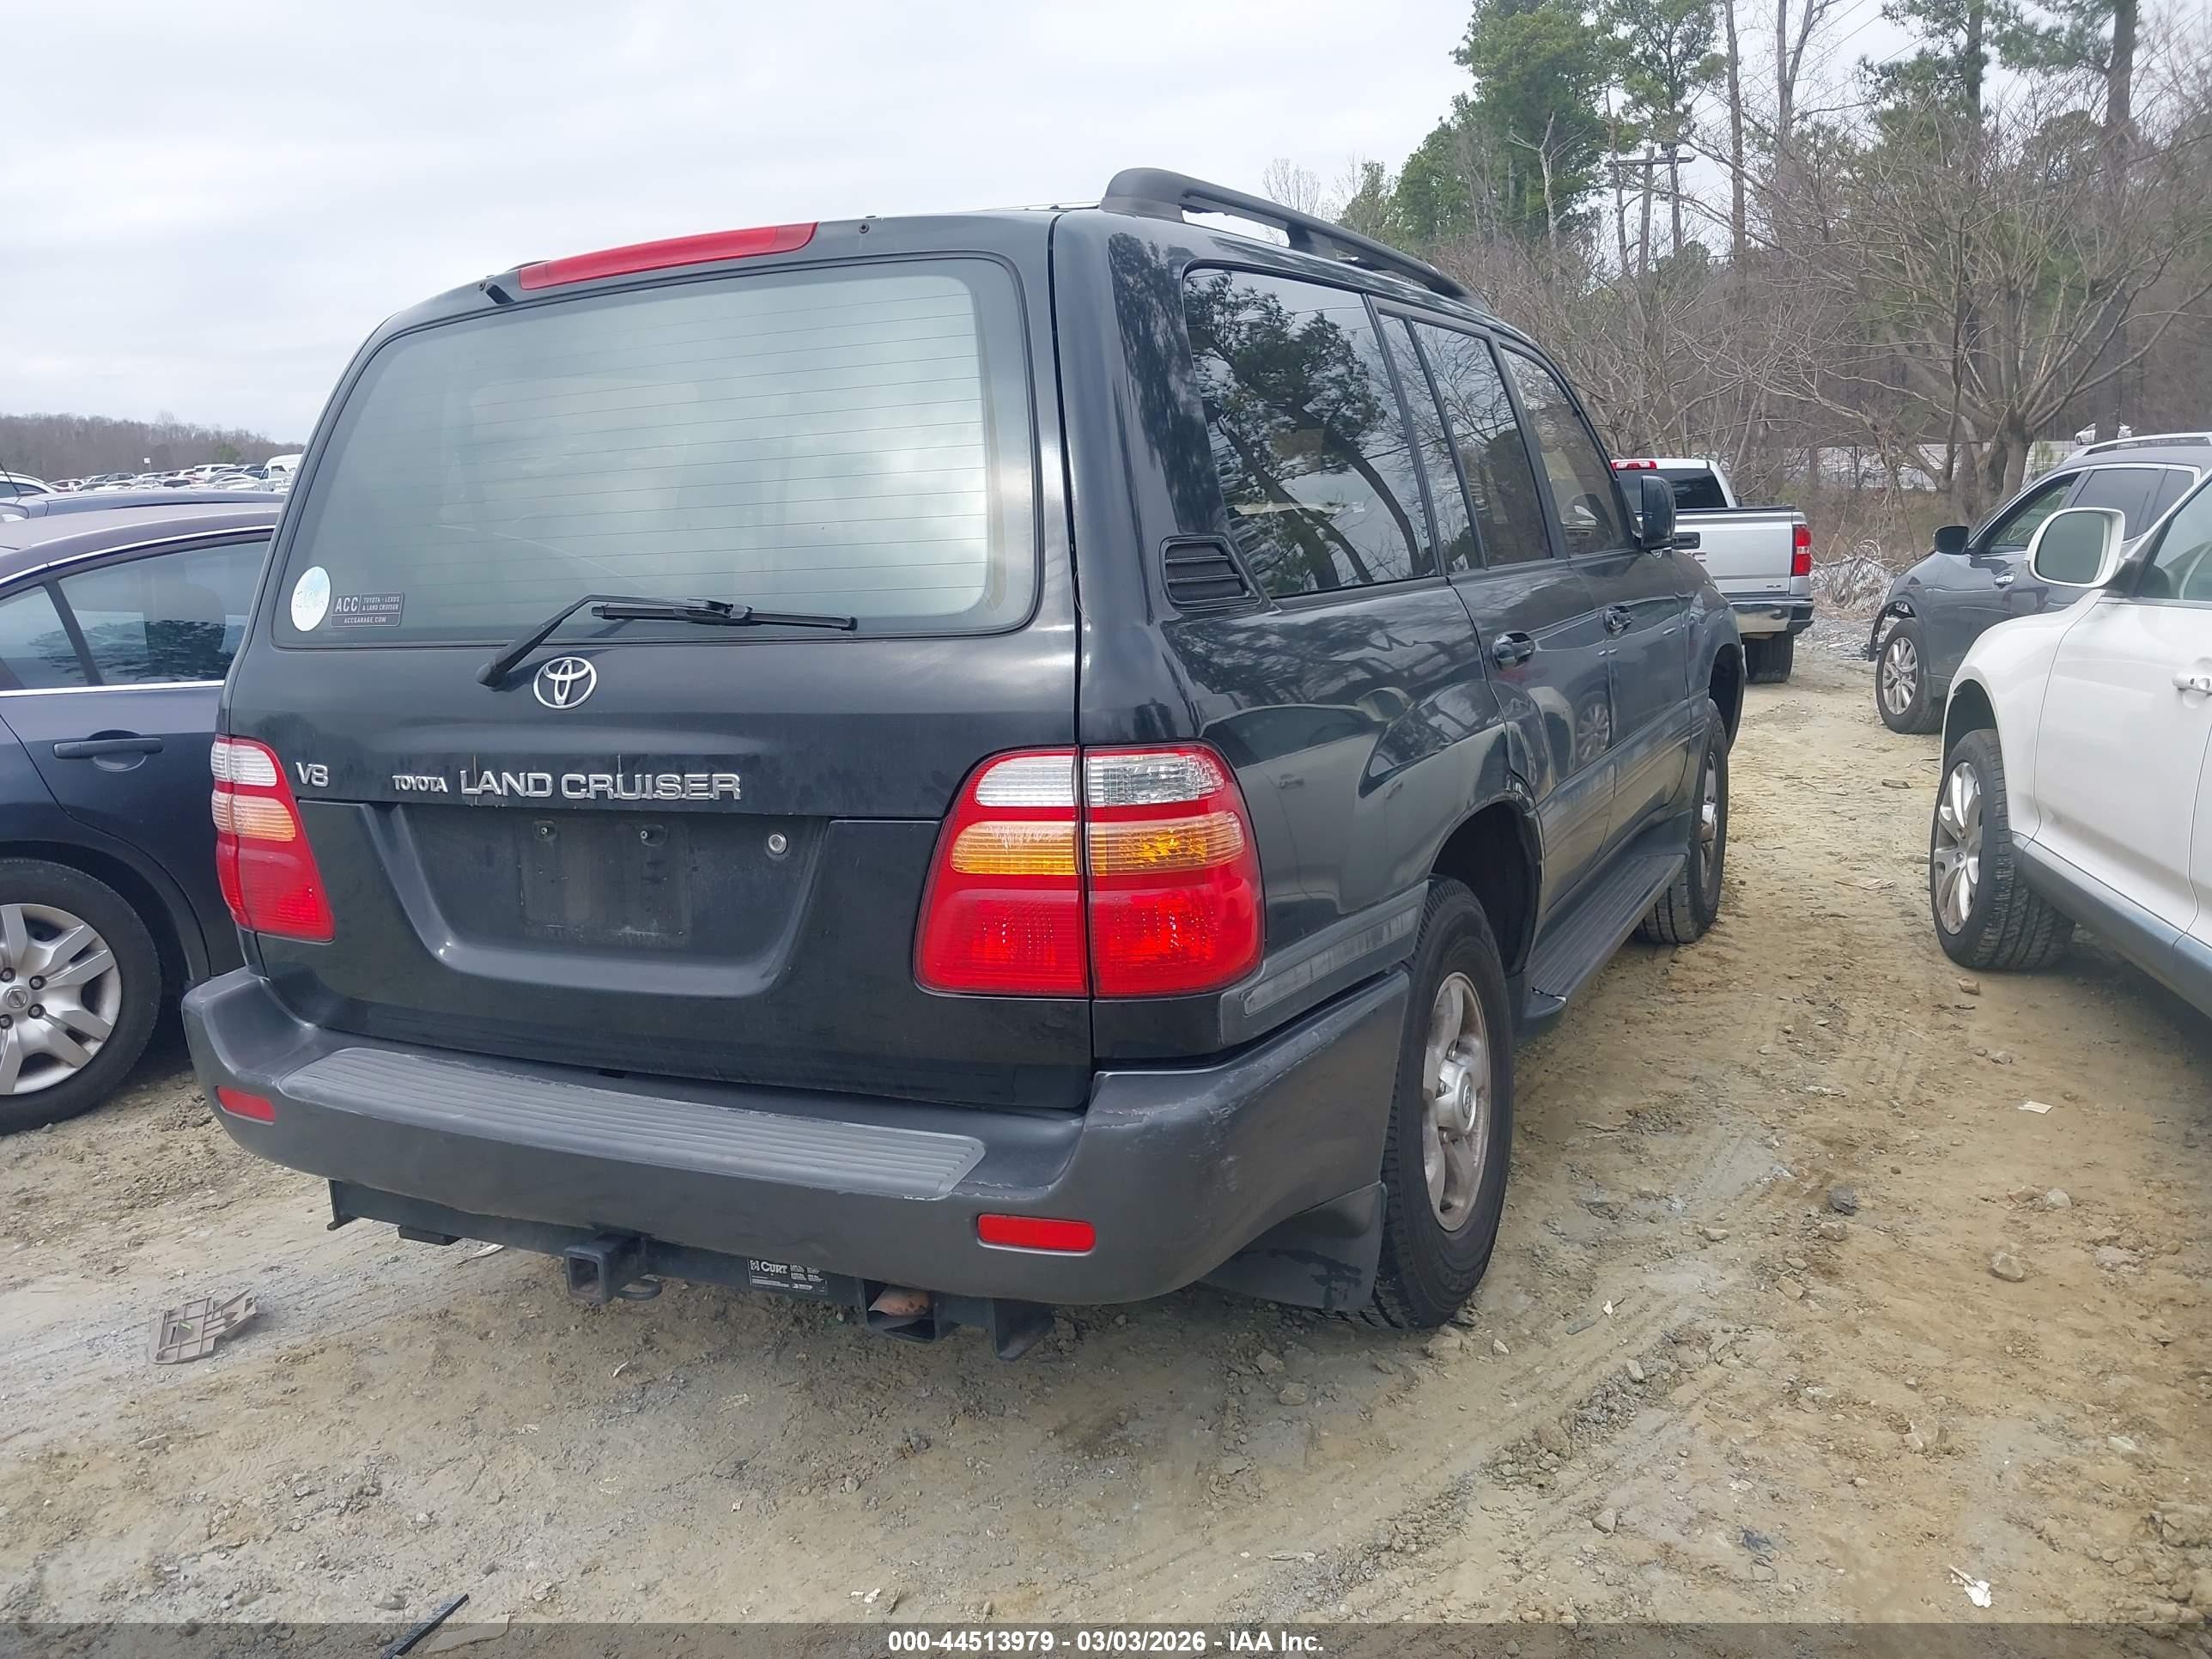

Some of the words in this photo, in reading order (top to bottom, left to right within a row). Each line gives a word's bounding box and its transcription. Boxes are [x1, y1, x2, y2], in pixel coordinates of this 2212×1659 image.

[335, 597, 358, 612] ACC
[295, 762, 329, 787] V8
[392, 775, 448, 793] TOYOTA
[459, 770, 553, 798] LAND
[561, 773, 742, 800] CRUISER
[760, 1261, 787, 1274] CURT
